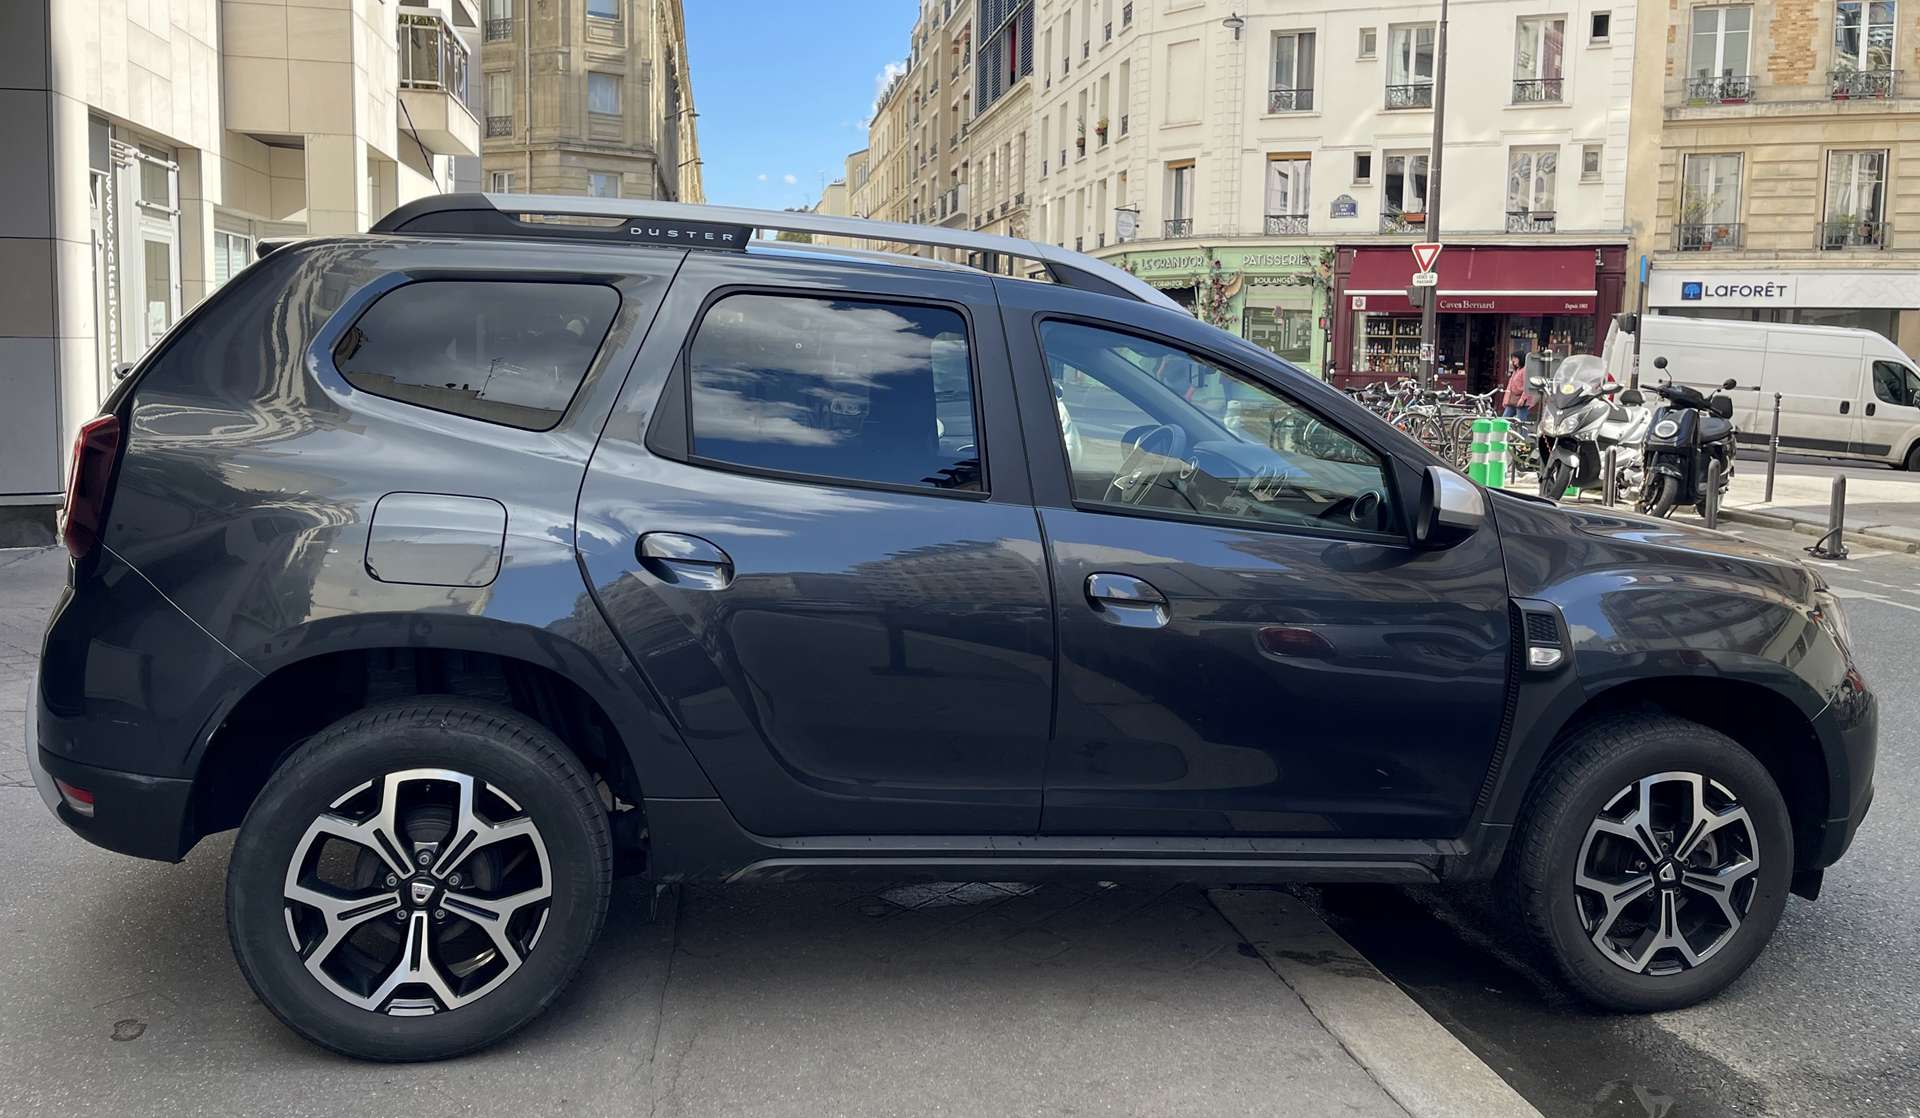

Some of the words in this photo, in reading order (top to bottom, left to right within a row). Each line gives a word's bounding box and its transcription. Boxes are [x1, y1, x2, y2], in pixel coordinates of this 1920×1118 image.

[630, 227, 734, 241] DUSTER
[1243, 254, 1309, 266] PATISSERIE
[1440, 300, 1462, 309] Caves
[1463, 300, 1495, 309] Bernard
